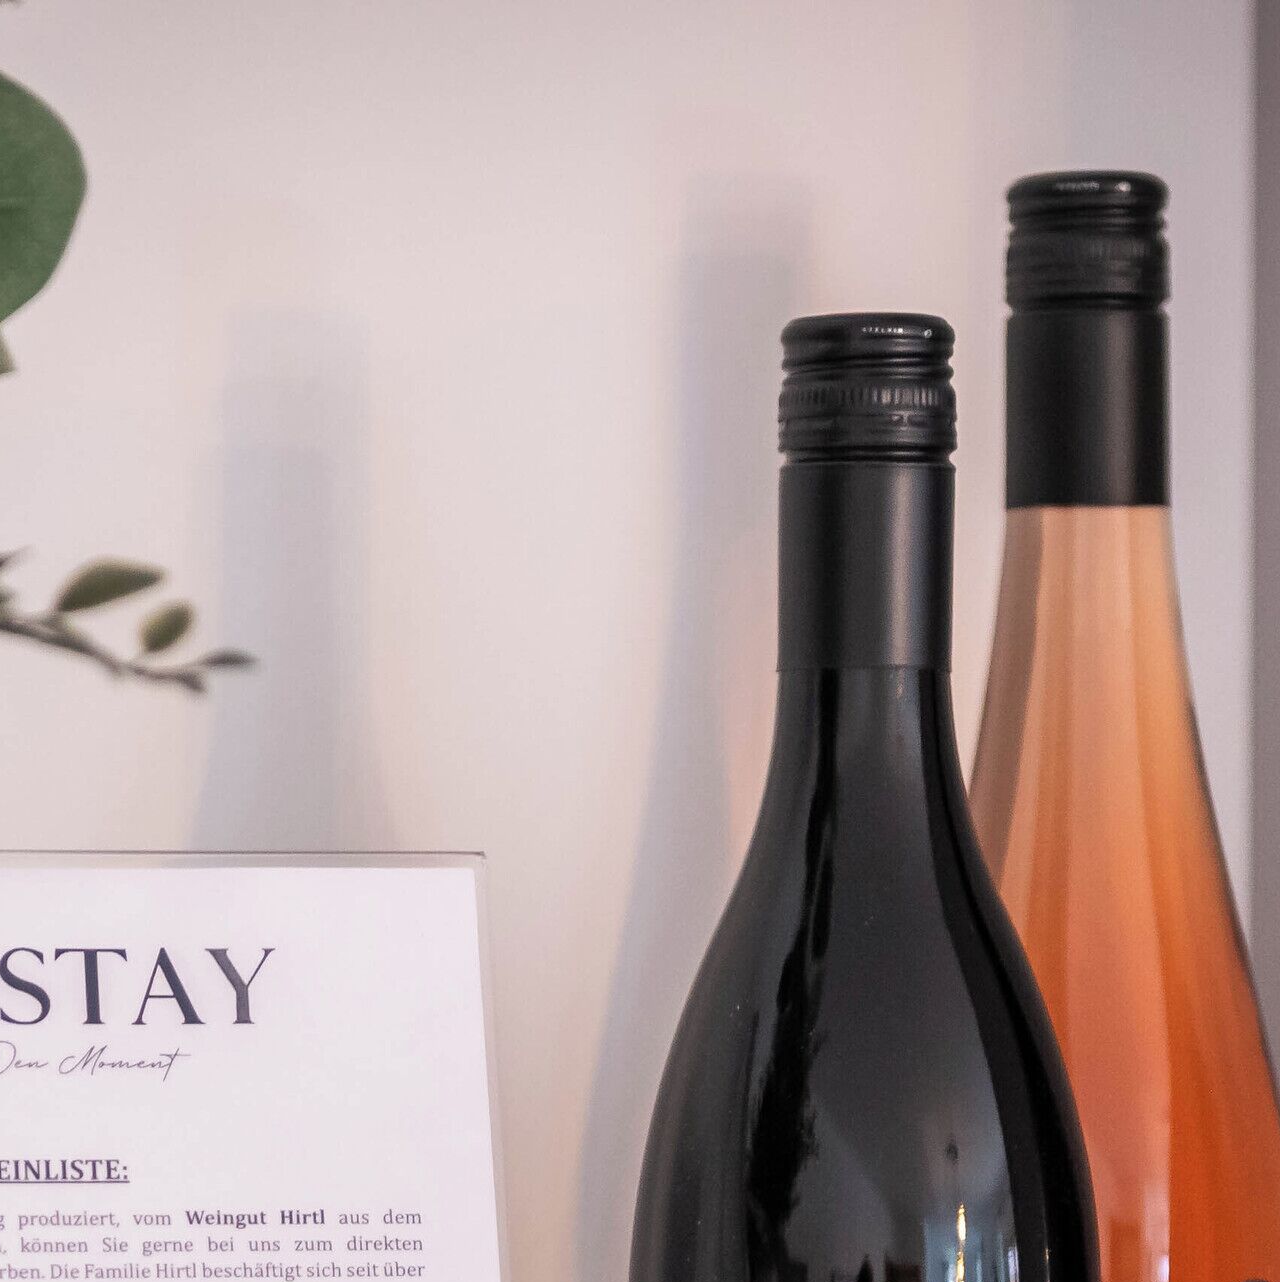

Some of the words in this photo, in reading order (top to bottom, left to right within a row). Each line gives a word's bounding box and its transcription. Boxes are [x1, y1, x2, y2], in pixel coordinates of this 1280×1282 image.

[58, 1045, 192, 1083] Moment
[18, 1211, 119, 1228] produziert,
[133, 1214, 171, 1226] vom
[185, 1210, 266, 1229] Weingut
[279, 1209, 325, 1225] Hirtl
[338, 1213, 369, 1224] aus
[382, 1209, 421, 1225] dem
[20, 1237, 88, 1253] können
[102, 1236, 128, 1253] Sie
[141, 1240, 194, 1256] gerne
[207, 1236, 234, 1252] bei
[248, 1240, 280, 1252] uns
[294, 1240, 333, 1252] zum
[346, 1235, 423, 1251] direkten
[50, 1263, 79, 1279] Die
[84, 1263, 151, 1279] Familie
[155, 1262, 197, 1279] Hirtl
[201, 1262, 302, 1282] beschäftigt
[306, 1262, 342, 1277] sich
[346, 1262, 378, 1277] seit
[383, 1262, 425, 1277] über
